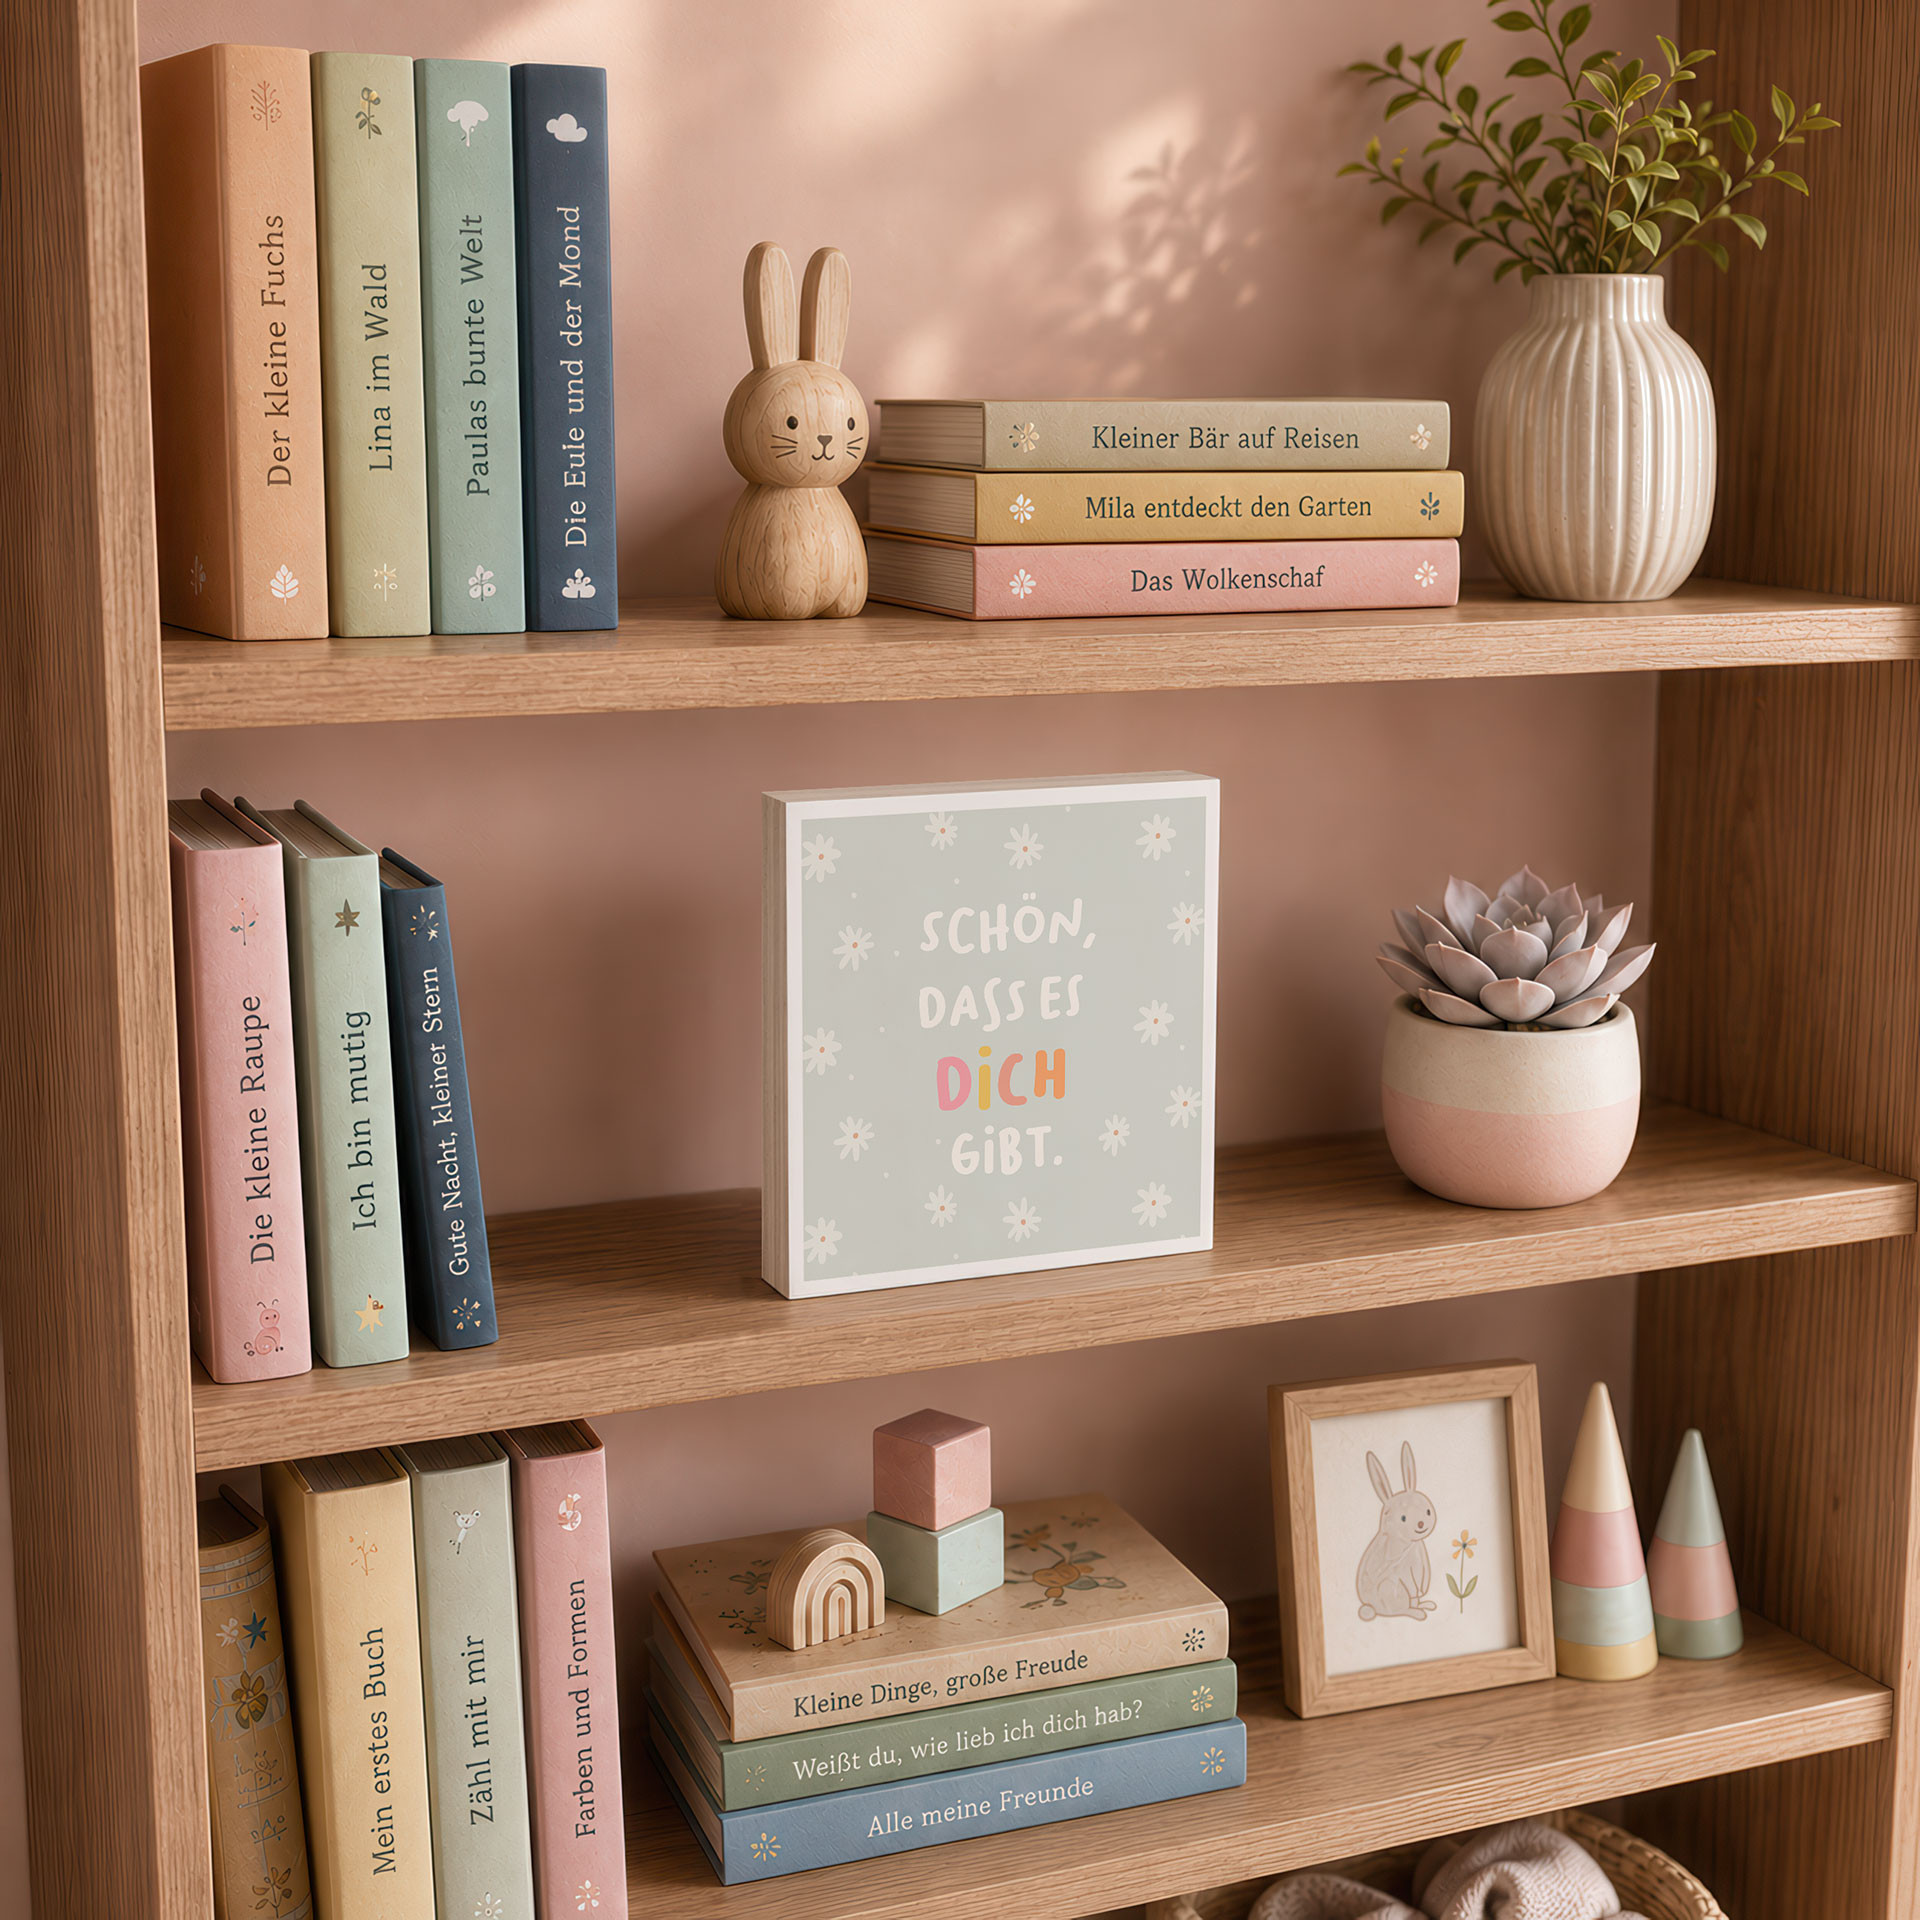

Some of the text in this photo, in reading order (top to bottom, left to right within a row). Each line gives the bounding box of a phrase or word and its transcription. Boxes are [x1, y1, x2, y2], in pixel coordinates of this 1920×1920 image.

[557, 206, 582, 289] Mond
[259, 214, 292, 487] Der kleine Fuchs
[459, 214, 490, 496] Paulas bunte Welt
[560, 300, 582, 348] der
[362, 264, 392, 471] Lina im Wald
[560, 360, 584, 414] und
[1092, 426, 1360, 449] Kleiner Bär auf Reisen
[565, 500, 588, 547] Die
[1086, 496, 1372, 520] Mila entdeckt den Garten
[1131, 566, 1324, 593] Das Wolkenschaf
[920, 892, 1096, 954] SCHÖN,
[918, 974, 1084, 1032] DASS ES
[241, 995, 274, 1265] Die kleine Raupe
[341, 1011, 376, 1230] Ich bin mutig
[422, 967, 470, 1276] Gute Nacht, kleiner Stern
[566, 1578, 595, 1839] Farben und Formen
[793, 1650, 1089, 1718] Kleine Dinge, große Freude
[360, 1626, 396, 1875] Mein erstes Buch
[460, 1636, 494, 1826] Zähl mit mir
[792, 1698, 1143, 1779] Weißt du, wie lieb ich dich hab?
[867, 1776, 1094, 1838] Alle meine Freunde
